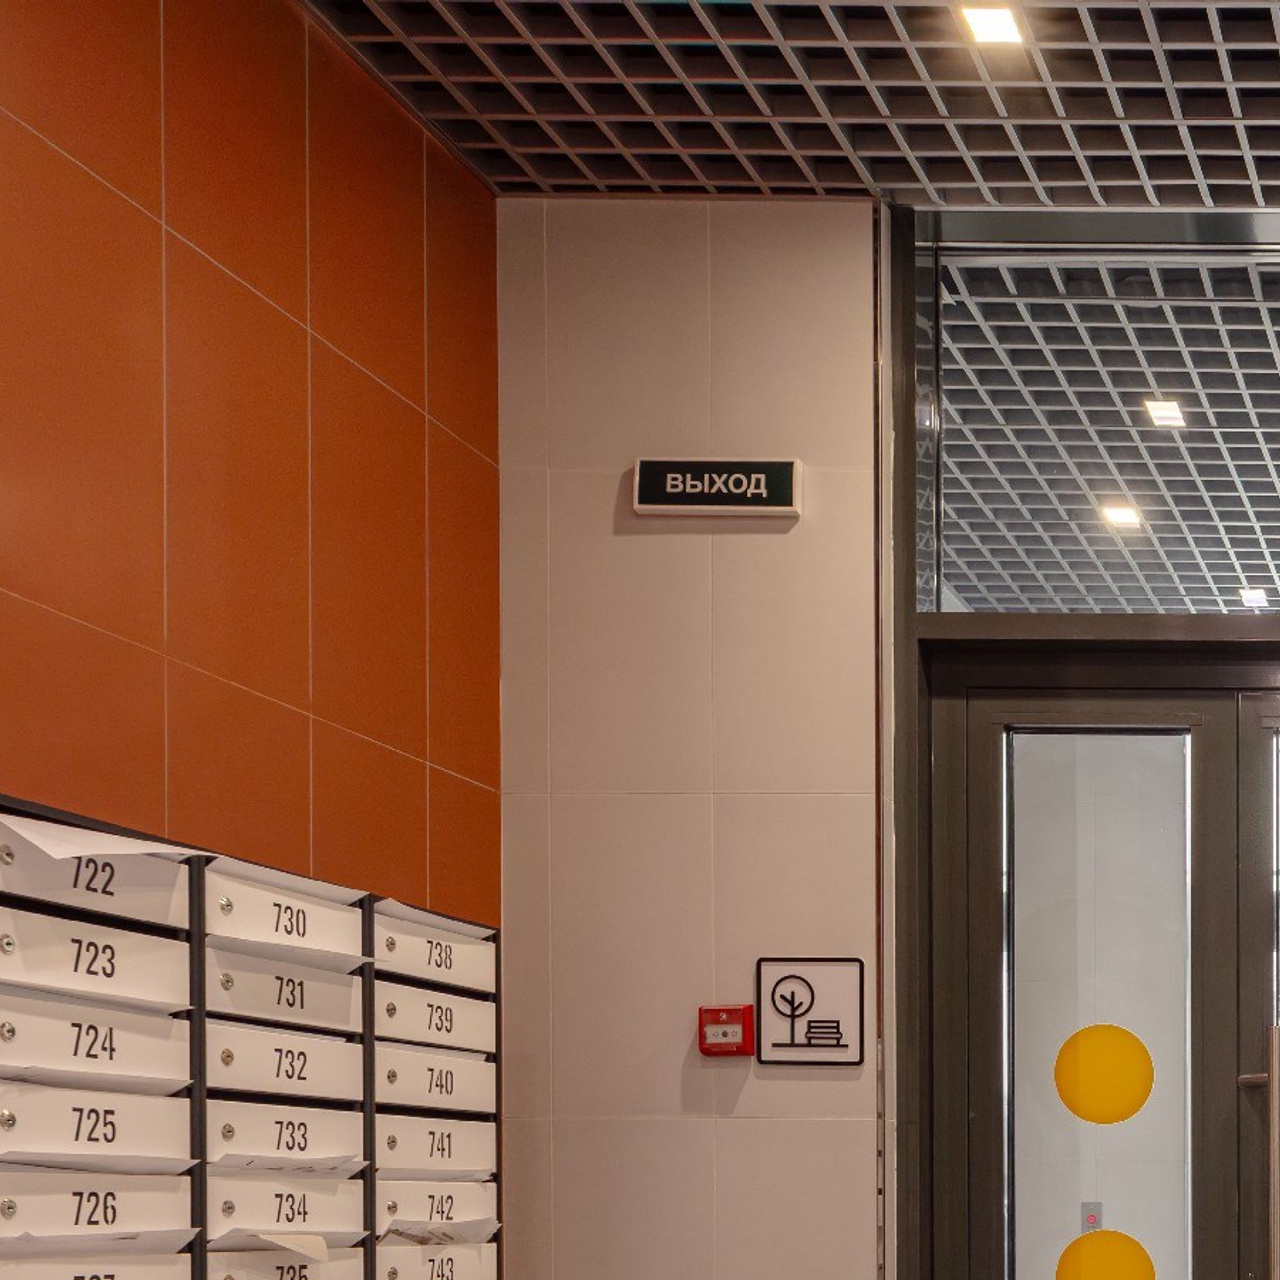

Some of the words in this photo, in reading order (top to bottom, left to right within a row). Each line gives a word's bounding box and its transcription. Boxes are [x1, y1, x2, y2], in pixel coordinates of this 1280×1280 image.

[666, 473, 767, 497] ВЫХОД
[72, 857, 114, 896] 722
[273, 902, 306, 937] 730
[71, 938, 115, 978] 723
[427, 940, 452, 969] 738
[275, 976, 304, 1009] 731
[427, 1003, 453, 1033] 739
[71, 1023, 115, 1060] 724
[275, 1048, 306, 1080] 732
[428, 1068, 453, 1095] 740
[72, 1107, 116, 1143] 725
[275, 1121, 307, 1151] 733
[429, 1131, 451, 1158] 741
[72, 1192, 116, 1225] 726
[275, 1194, 308, 1222] 734
[428, 1195, 453, 1221] 742
